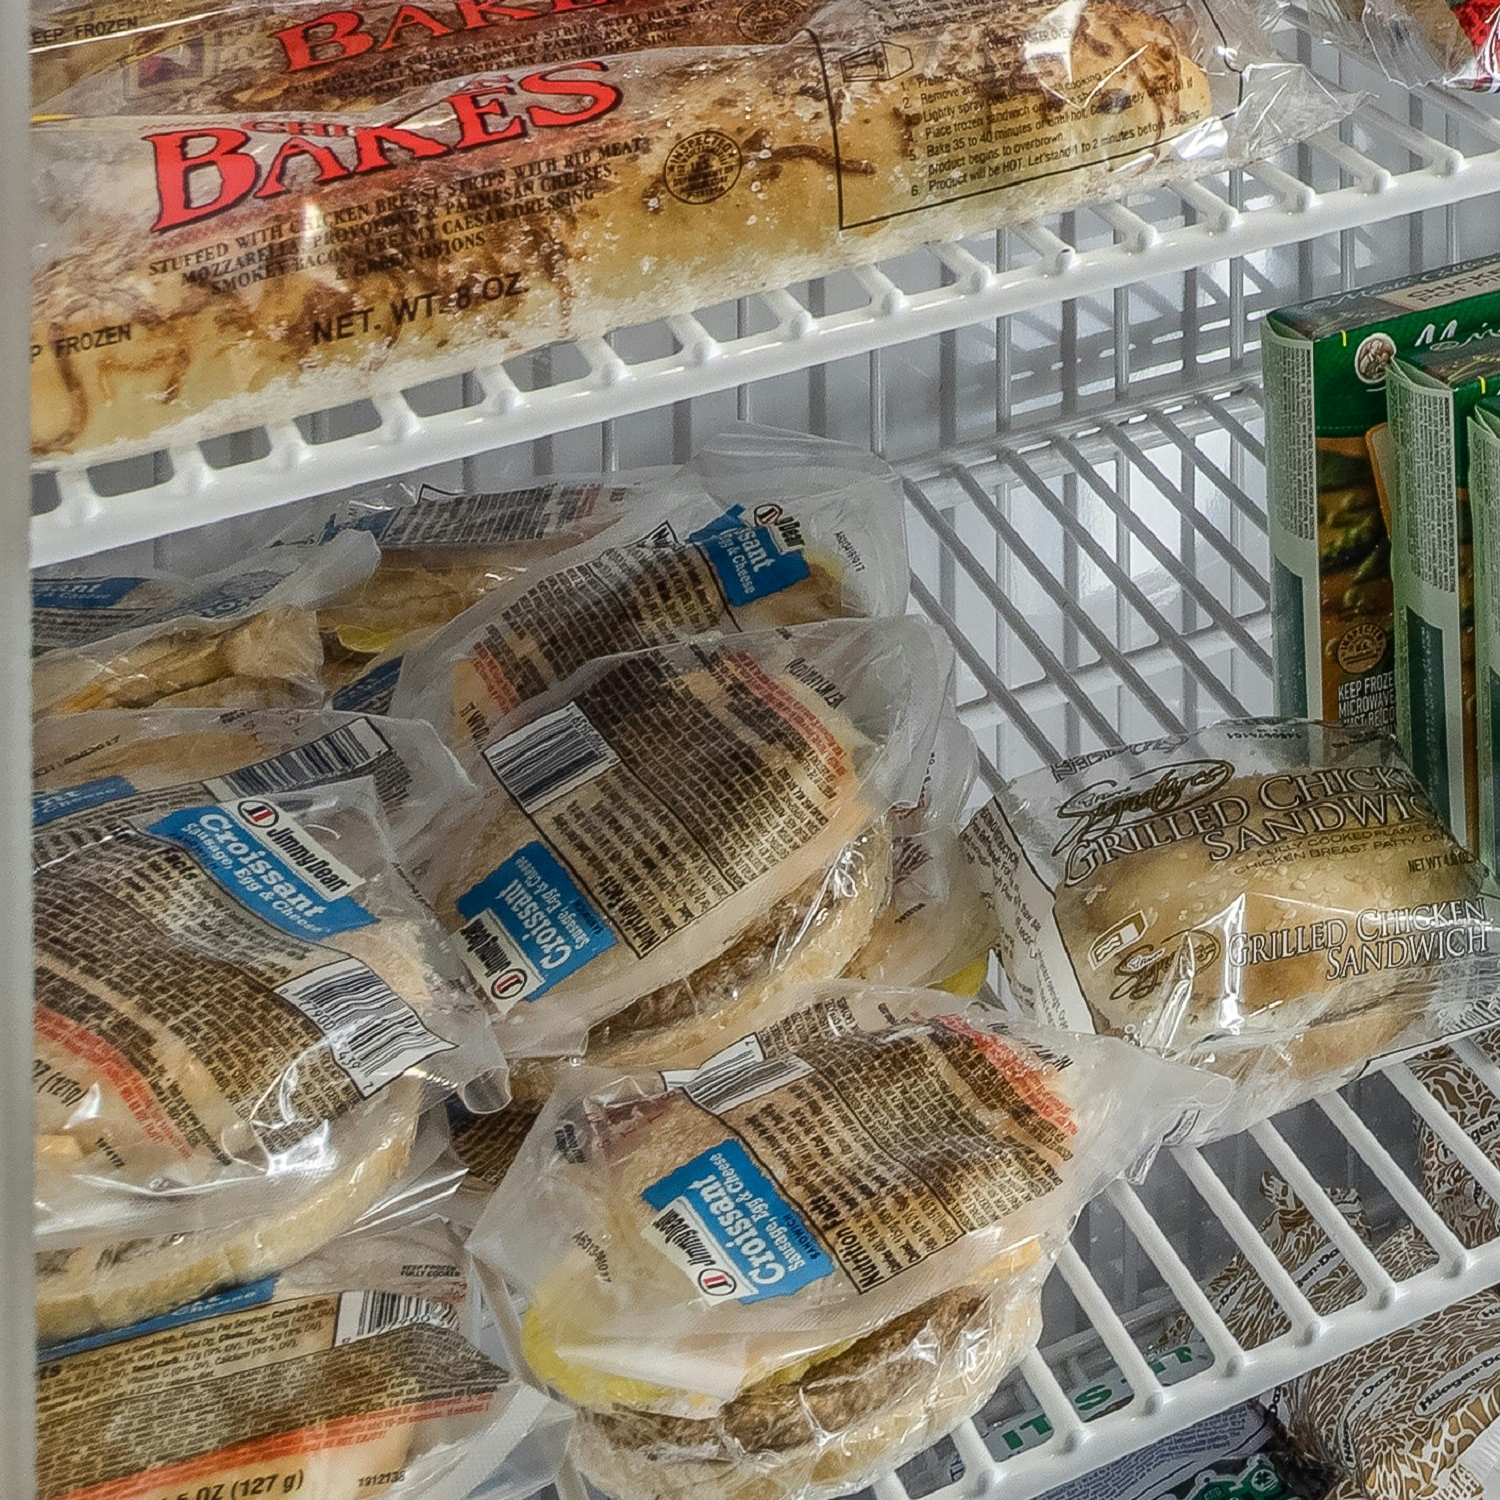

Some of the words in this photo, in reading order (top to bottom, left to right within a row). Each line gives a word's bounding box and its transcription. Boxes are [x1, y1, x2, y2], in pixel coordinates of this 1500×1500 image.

[73, 15, 139, 41] FROZEN
[141, 61, 623, 235] BAKES
[926, 143, 951, 158] Bake
[953, 137, 965, 151] 35
[994, 123, 1032, 141] minutes
[448, 169, 509, 197] STRIPS
[511, 157, 559, 179] WITH
[563, 150, 594, 169] RIB
[598, 137, 643, 159] MEAT
[928, 158, 966, 177] product
[969, 149, 1001, 167] begins
[928, 173, 968, 192] Product
[970, 169, 986, 183] will
[1002, 159, 1026, 176] HOT.
[445, 182, 535, 215] PARMESAN
[539, 163, 620, 193] CHEESES.
[511, 188, 597, 220] DRESSING
[149, 245, 229, 276] STUFFED
[236, 224, 286, 250] WITH
[310, 307, 382, 346] NET.
[391, 293, 449, 325] WT.
[454, 283, 473, 308] 8
[482, 271, 530, 301] OZ.
[54, 322, 132, 358] FROZEN
[1337, 679, 1362, 701] KEEP
[1065, 796, 1249, 886] GRILLED
[1307, 831, 1372, 847] COOKED
[200, 813, 327, 918] Croissant
[1234, 851, 1308, 875] CHICKEN
[1310, 844, 1369, 858] BREAST
[234, 868, 263, 892] Egg
[496, 878, 572, 970] Croissant
[1227, 918, 1348, 967] GRILLED
[1356, 898, 1485, 942] CHICKEN
[1326, 927, 1489, 980] SANDWICH
[710, 1153, 744, 1193] Cheese
[686, 1174, 786, 1285] Croissant
[809, 1194, 840, 1232] Facts
[837, 1228, 885, 1287] Nutrition
[198, 1484, 225, 1500] OZ
[231, 1474, 278, 1499] (127
